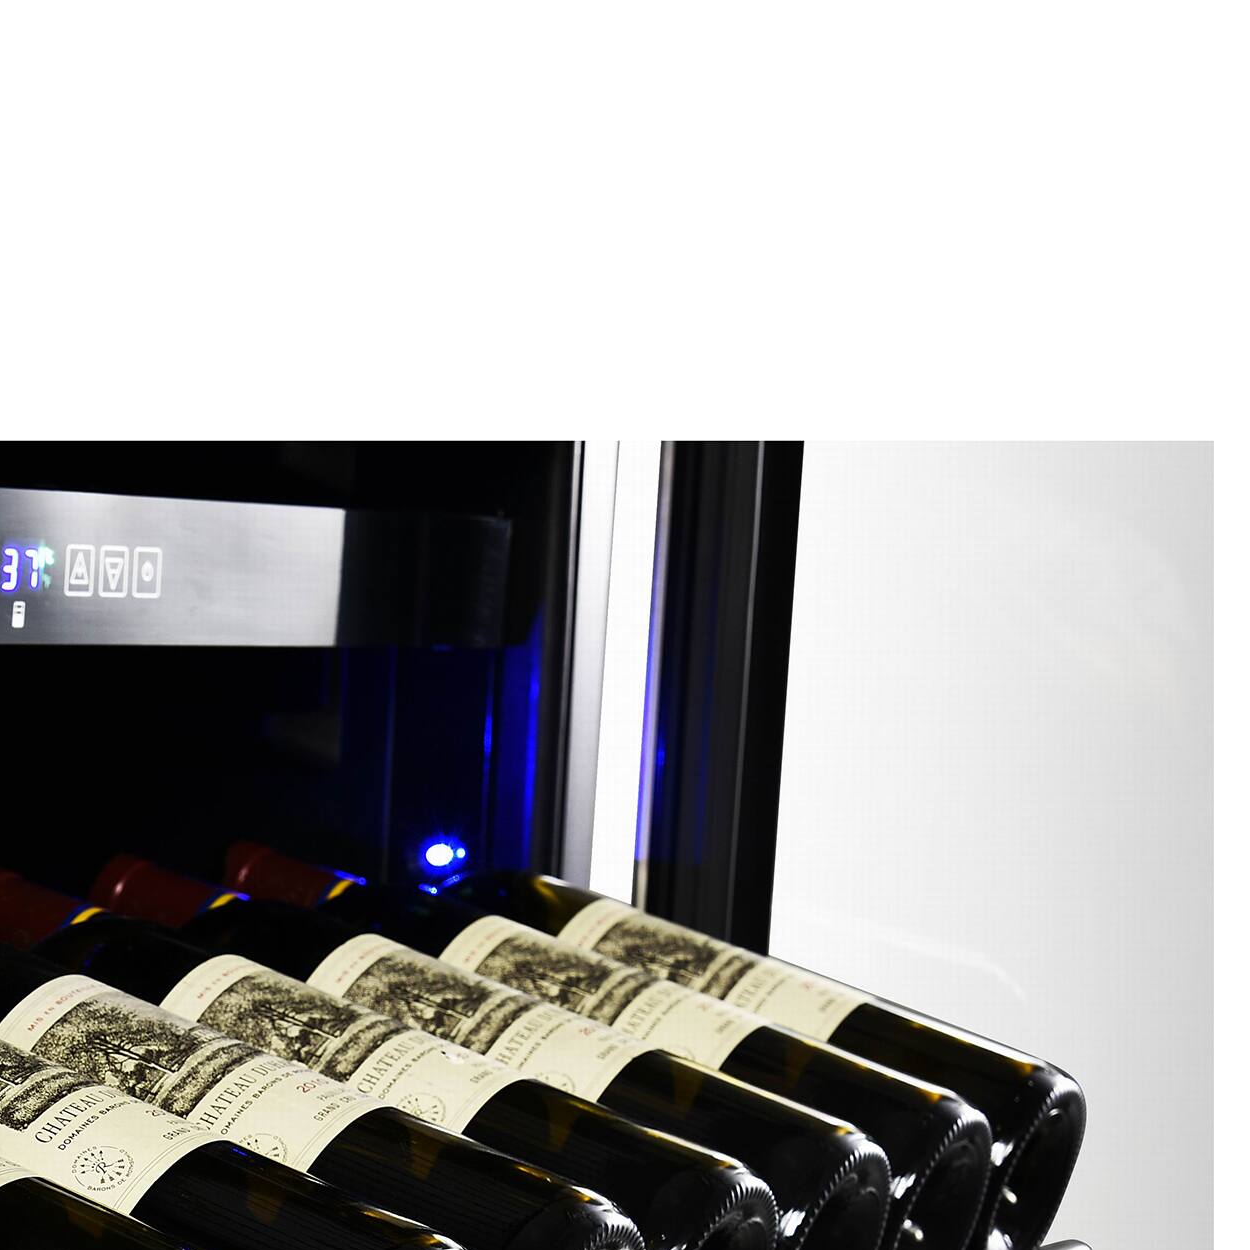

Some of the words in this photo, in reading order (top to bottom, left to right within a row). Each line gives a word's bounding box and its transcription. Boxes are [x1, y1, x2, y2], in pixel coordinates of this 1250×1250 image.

[1, 548, 39, 591] 37
[35, 1091, 104, 1144] CHATEAU
[197, 1072, 257, 1130] HATEAU
[220, 1099, 253, 1135] OMAINES
[58, 1114, 99, 1151] DOMAINES
